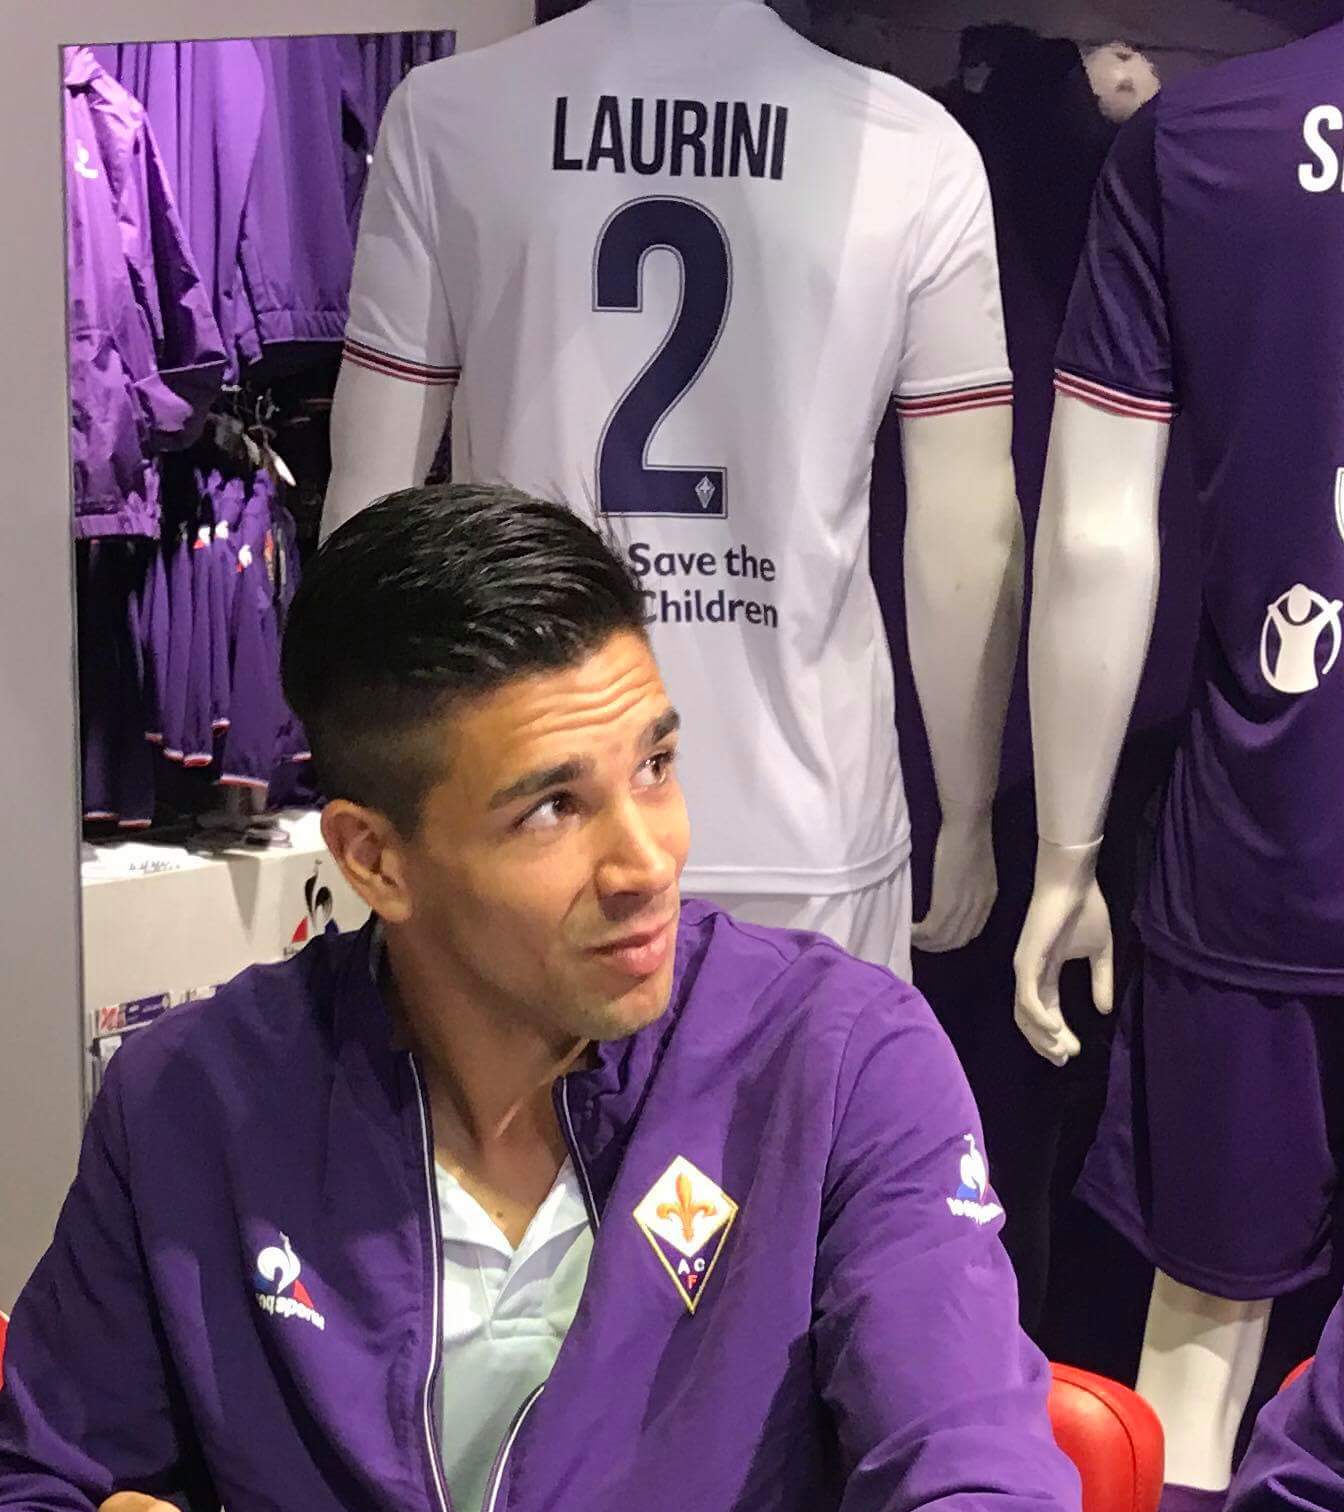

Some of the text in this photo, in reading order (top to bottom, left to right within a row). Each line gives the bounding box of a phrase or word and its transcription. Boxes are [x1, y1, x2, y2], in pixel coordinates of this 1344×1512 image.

[551, 96, 788, 180] LAURINI
[591, 195, 733, 519] 2
[629, 543, 776, 582] Save the
